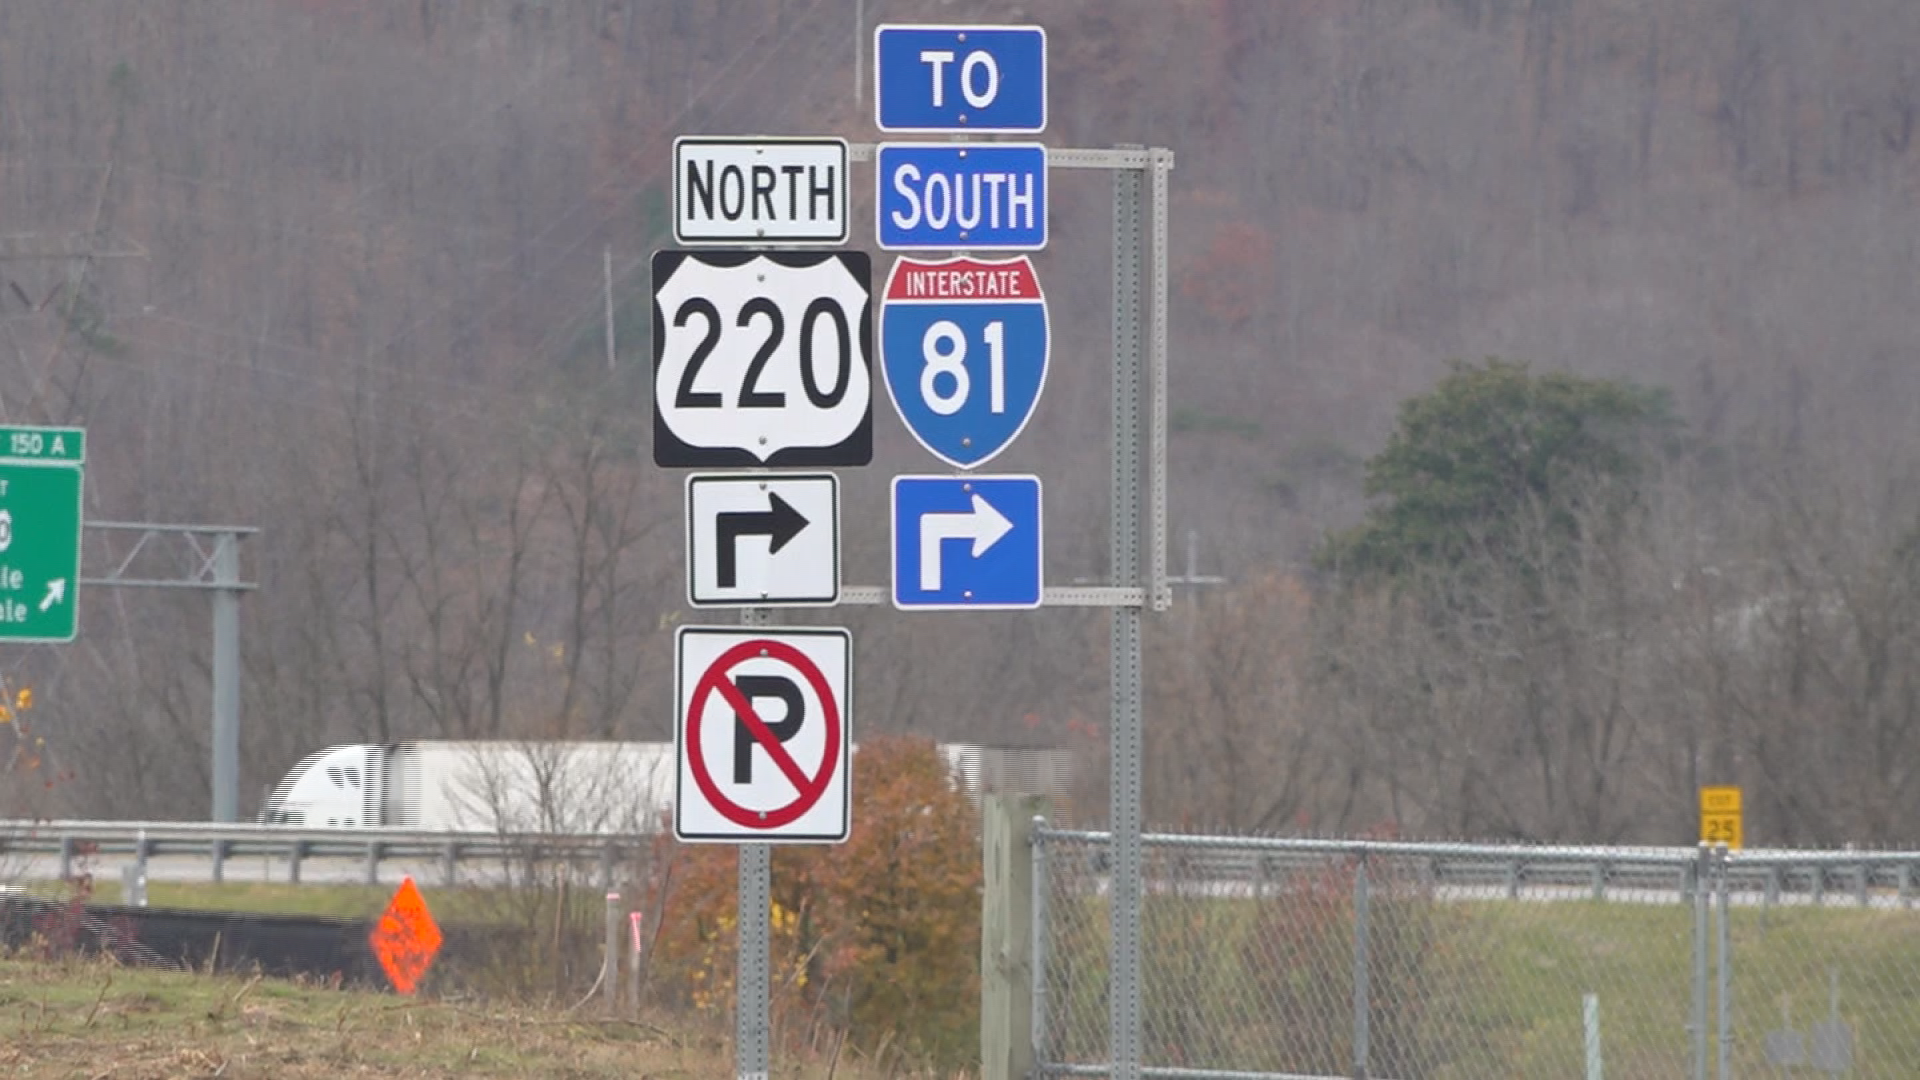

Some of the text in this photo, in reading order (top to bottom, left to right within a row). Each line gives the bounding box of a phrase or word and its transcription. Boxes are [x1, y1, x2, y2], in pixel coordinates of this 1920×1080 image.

[920, 50, 1000, 109] TO
[686, 159, 836, 221] NORTH
[891, 163, 1034, 230] SOUTH
[906, 271, 1021, 297] INTERSTATE
[673, 296, 852, 409] 220
[920, 320, 1005, 416] 81
[10, 432, 66, 455] 150 A
[733, 675, 806, 784] P
[1707, 819, 1734, 842] 25
